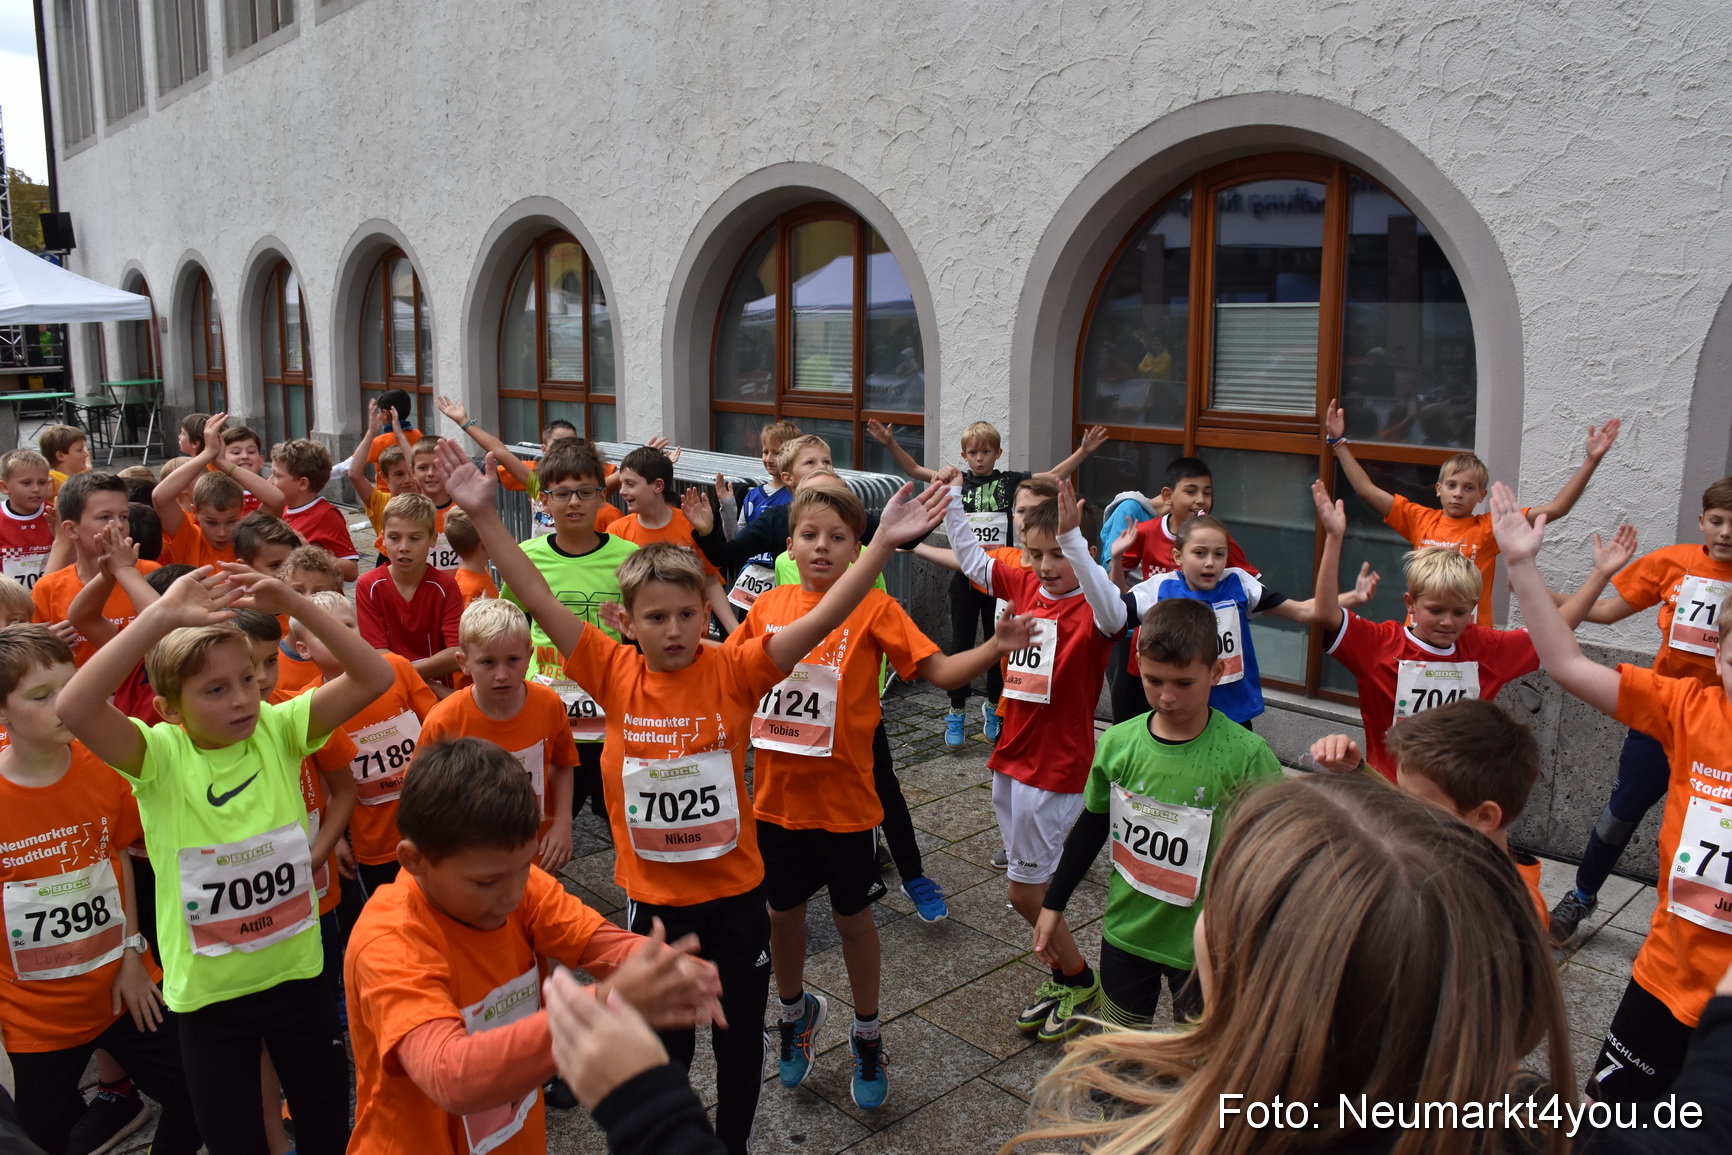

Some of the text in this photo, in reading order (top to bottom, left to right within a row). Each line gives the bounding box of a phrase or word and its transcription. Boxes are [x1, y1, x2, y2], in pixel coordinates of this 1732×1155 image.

[972, 527, 1000, 542] 392
[624, 713, 691, 728] Neumarkter
[623, 729, 678, 745] Stadtlauf
[769, 724, 800, 737] Tobias
[354, 738, 415, 778] 7189
[660, 764, 700, 778] BOCK
[639, 785, 720, 823] 7025
[1142, 804, 1179, 822] BOCK
[0, 825, 79, 853] Neumarkter
[665, 832, 702, 845] Niklas
[2, 841, 68, 869] Stadtlauf
[231, 842, 275, 864] BOCK
[1676, 864, 1686, 873] B6
[51, 877, 91, 895] BOCK
[203, 862, 296, 915] 7099
[25, 895, 111, 942] 7398
[240, 915, 273, 935] Attila
[36, 950, 86, 966] Lukas
[495, 981, 538, 1014] BOCK
[1595, 1051, 1624, 1083] 7
